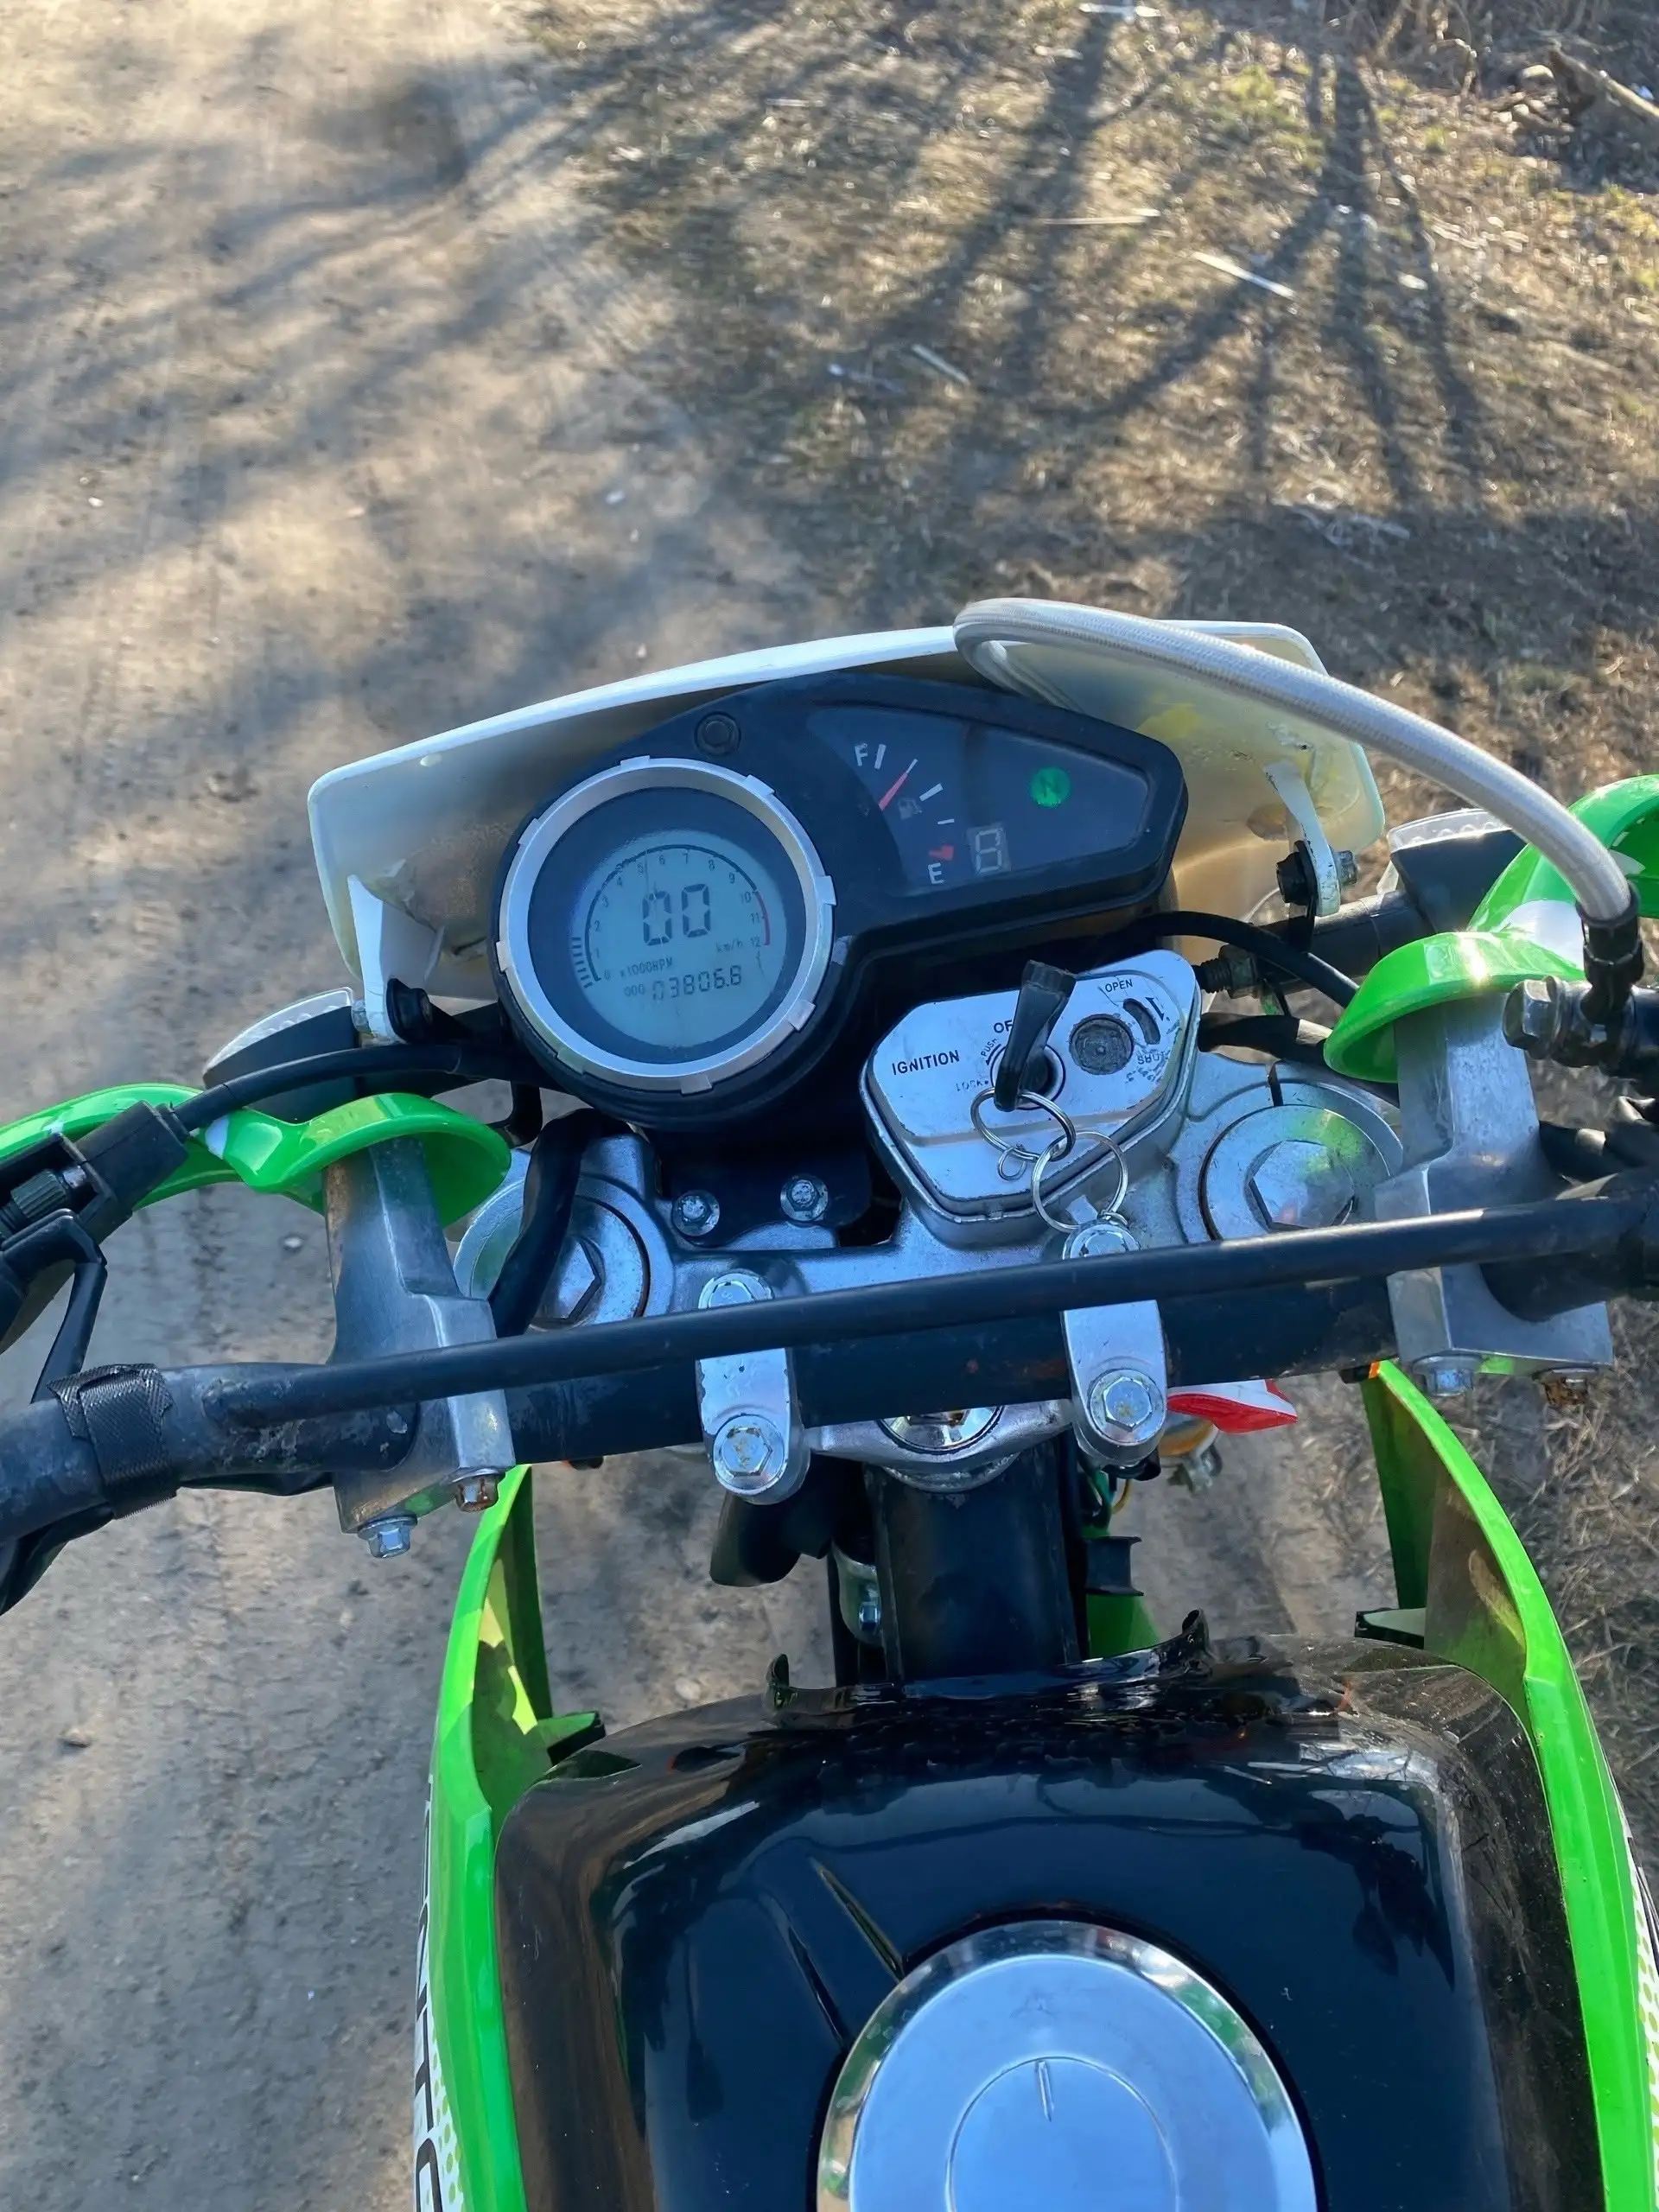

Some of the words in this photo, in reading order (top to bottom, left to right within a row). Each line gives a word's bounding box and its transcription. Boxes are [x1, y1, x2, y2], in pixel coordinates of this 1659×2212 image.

[854, 743, 868, 766] F
[658, 855, 666, 865] 6
[708, 859, 715, 871] 8
[728, 873, 735, 884] 9
[927, 861, 944, 885] E
[594, 919, 601, 931] 2
[1104, 979, 1134, 993] OPEN
[993, 1020, 1014, 1034] OF
[892, 1049, 960, 1076] IGNITION
